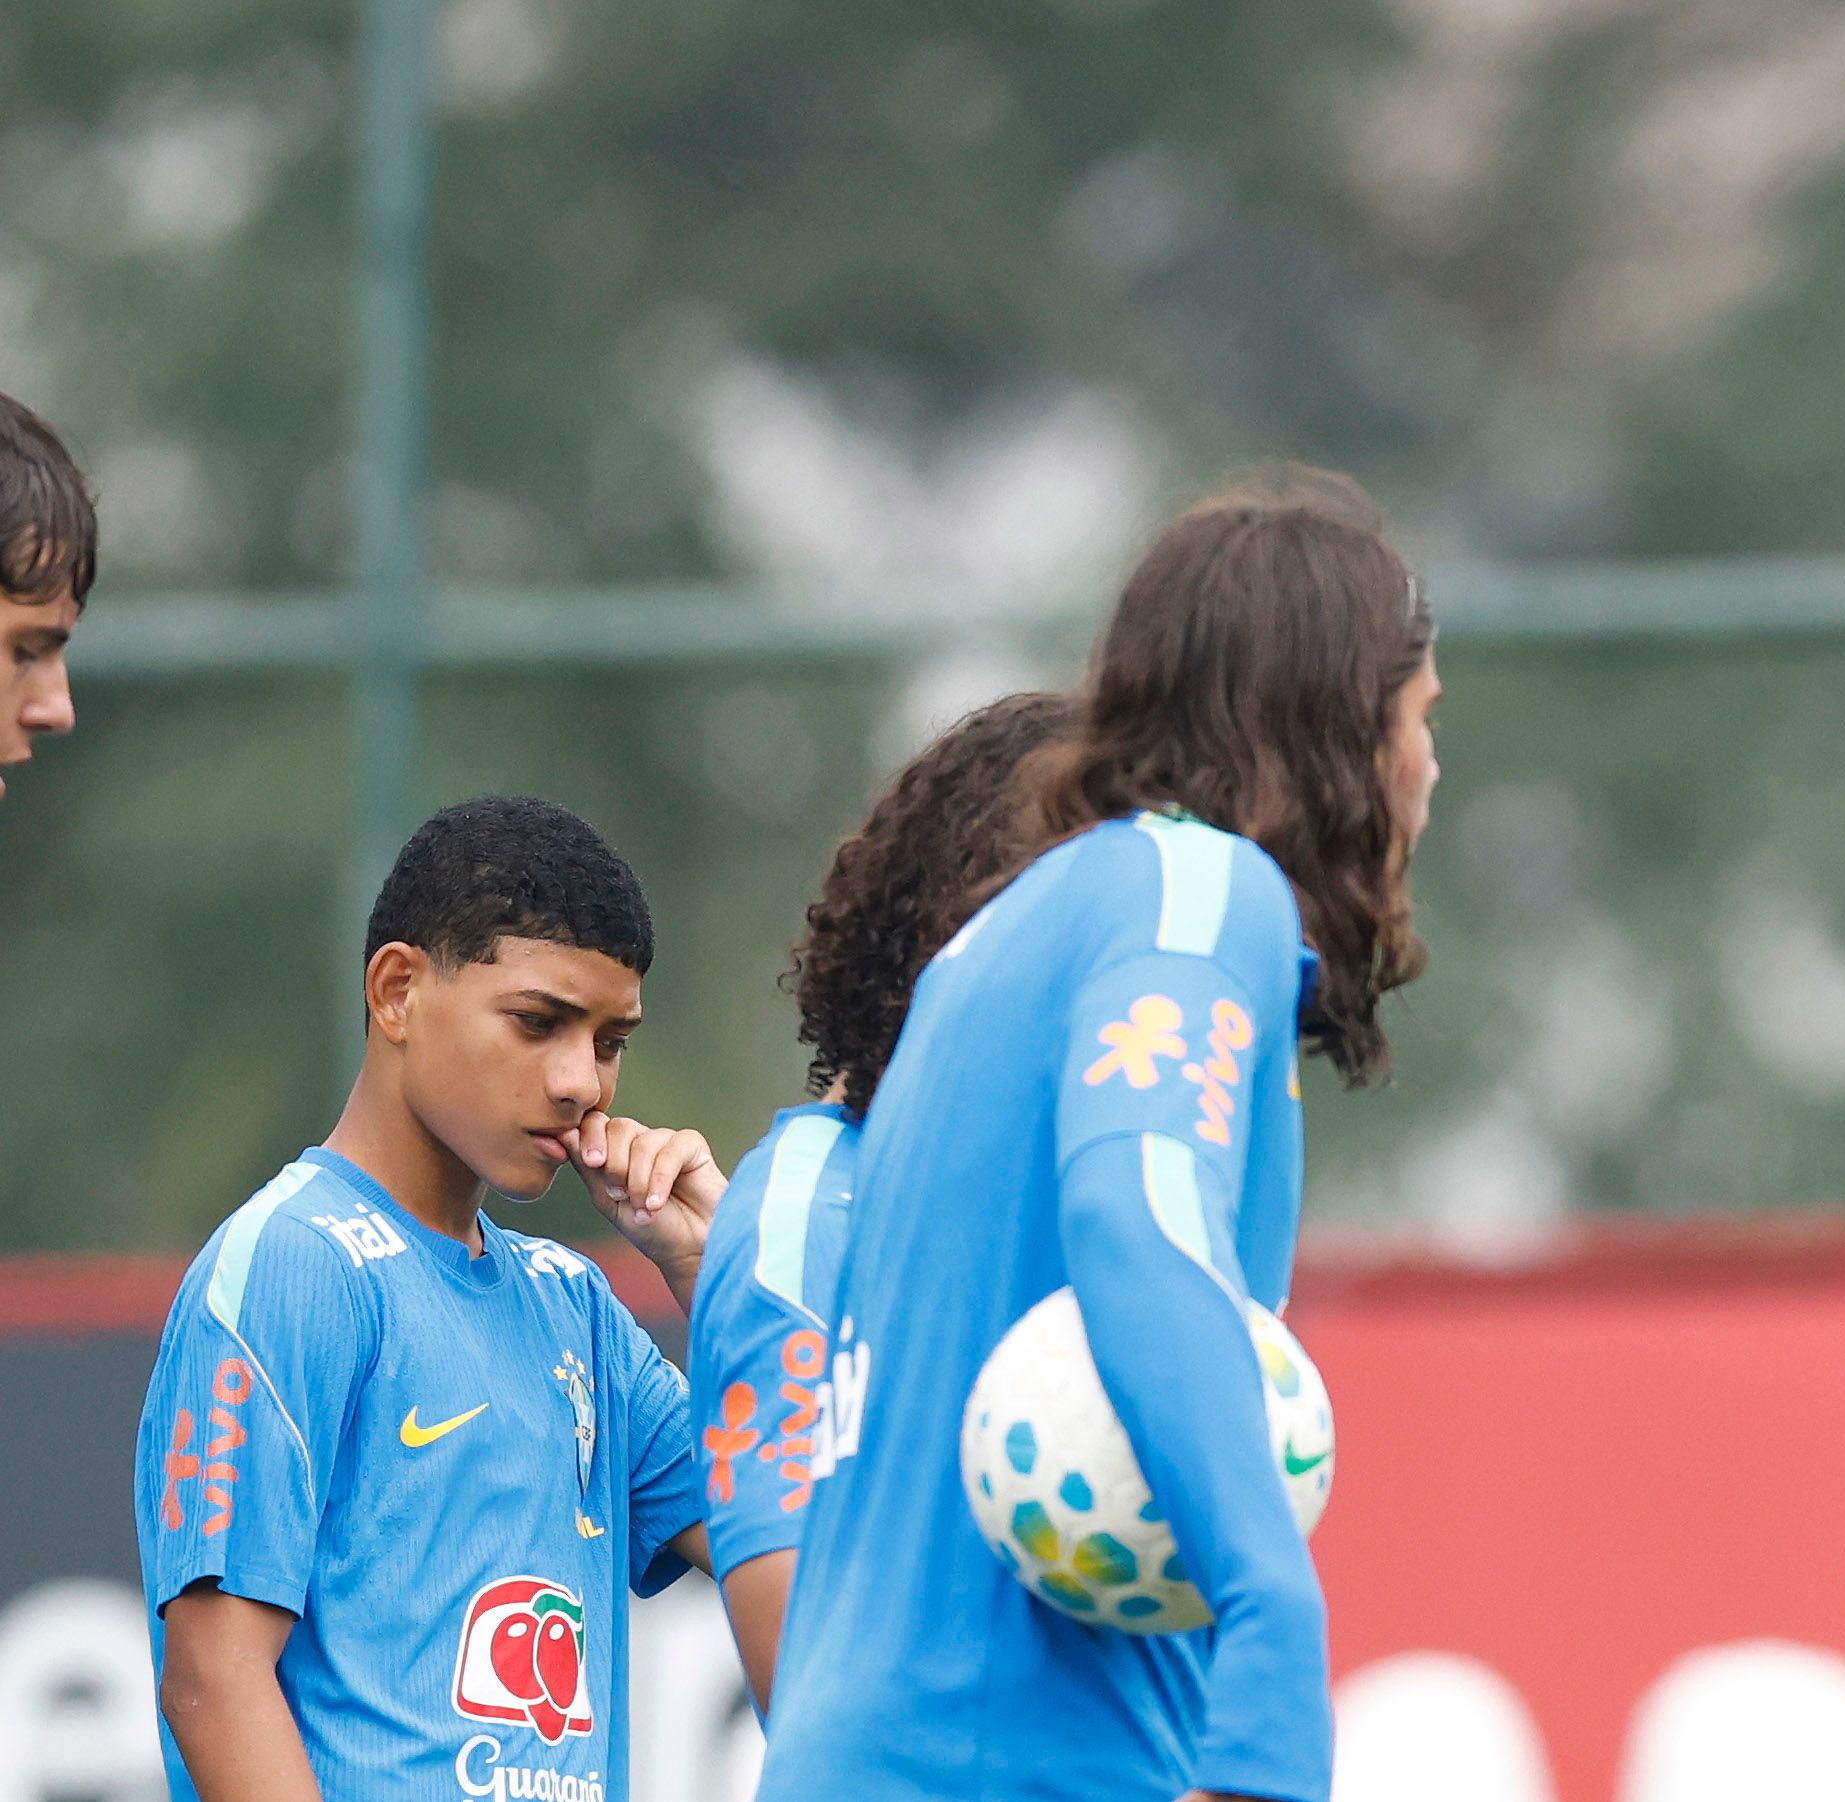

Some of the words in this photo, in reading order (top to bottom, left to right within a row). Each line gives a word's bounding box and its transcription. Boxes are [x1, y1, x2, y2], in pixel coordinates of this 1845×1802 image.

[1180, 998, 1254, 1148] vivo
[311, 1202, 409, 1268] itaú
[201, 1357, 255, 1537] vivo
[758, 1329, 828, 1513] vivo
